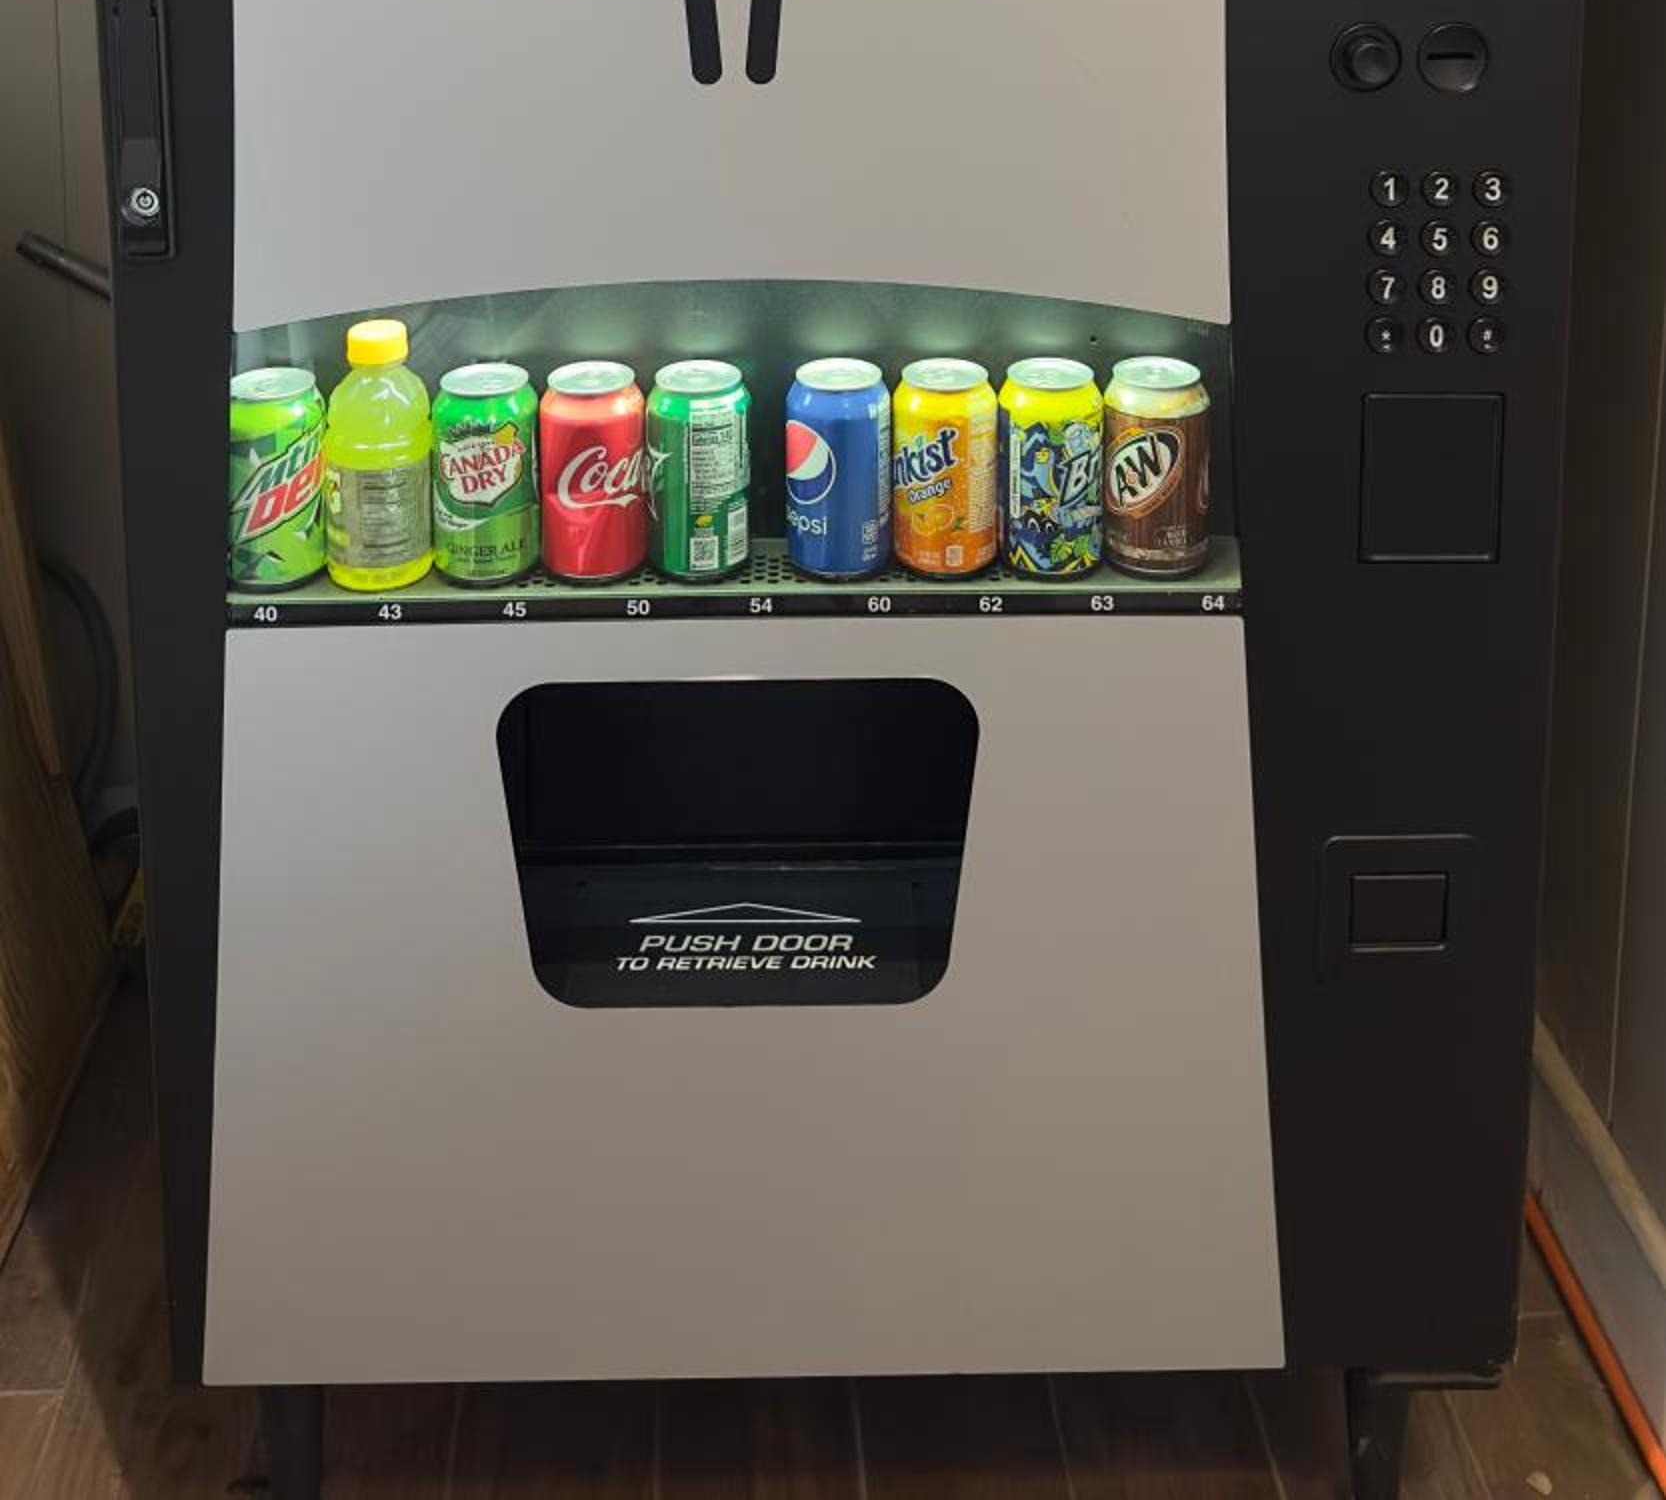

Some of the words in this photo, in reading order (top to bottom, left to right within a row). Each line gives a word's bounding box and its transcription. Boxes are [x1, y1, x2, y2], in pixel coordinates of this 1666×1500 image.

[1383, 177, 1395, 201] 1
[1434, 177, 1449, 200] 2
[1485, 177, 1501, 201] 3
[1380, 227, 1396, 249] 4
[1432, 227, 1448, 250] 5
[1483, 227, 1499, 250] 6
[1381, 276, 1395, 299] 7
[1431, 276, 1445, 299] 8
[1482, 275, 1498, 299] 9
[1429, 325, 1444, 348] 0
[440, 436, 526, 483] CANADA
[462, 467, 509, 494] DRY
[254, 606, 278, 622] 40
[378, 604, 401, 620] 43
[503, 602, 527, 617] 45
[626, 600, 650, 615] 50
[750, 598, 773, 613] 54
[867, 597, 891, 612] 60
[979, 596, 1003, 612] 62
[1091, 595, 1114, 611] 63
[1201, 595, 1225, 611] 64
[640, 934, 741, 952] PUSH
[752, 934, 854, 951] DOOR
[617, 956, 650, 971] TO
[656, 955, 784, 971] RETRIEVE
[790, 955, 877, 970] DRINK
